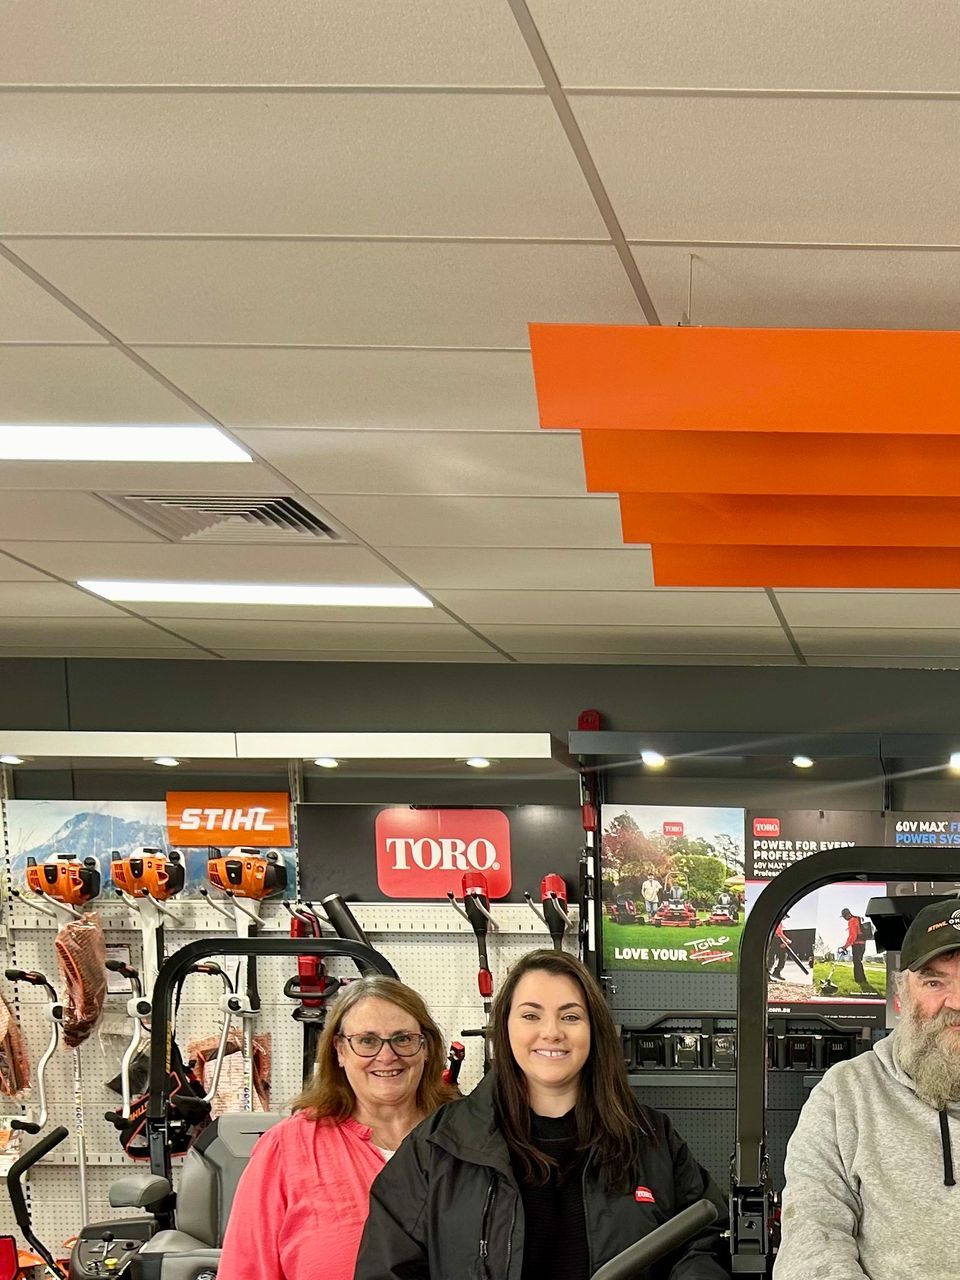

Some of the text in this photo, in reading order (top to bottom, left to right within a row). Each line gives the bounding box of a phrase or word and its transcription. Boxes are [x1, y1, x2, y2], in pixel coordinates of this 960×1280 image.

[179, 807, 275, 831] STIHL
[755, 823, 778, 831] TORO
[895, 821, 918, 832] 60V
[895, 834, 937, 844] POWER
[753, 840, 793, 850] POWER
[795, 840, 818, 851] FOR
[753, 851, 817, 861] PROFESSI
[614, 947, 649, 959] LOVE
[651, 948, 688, 961] YOUR
